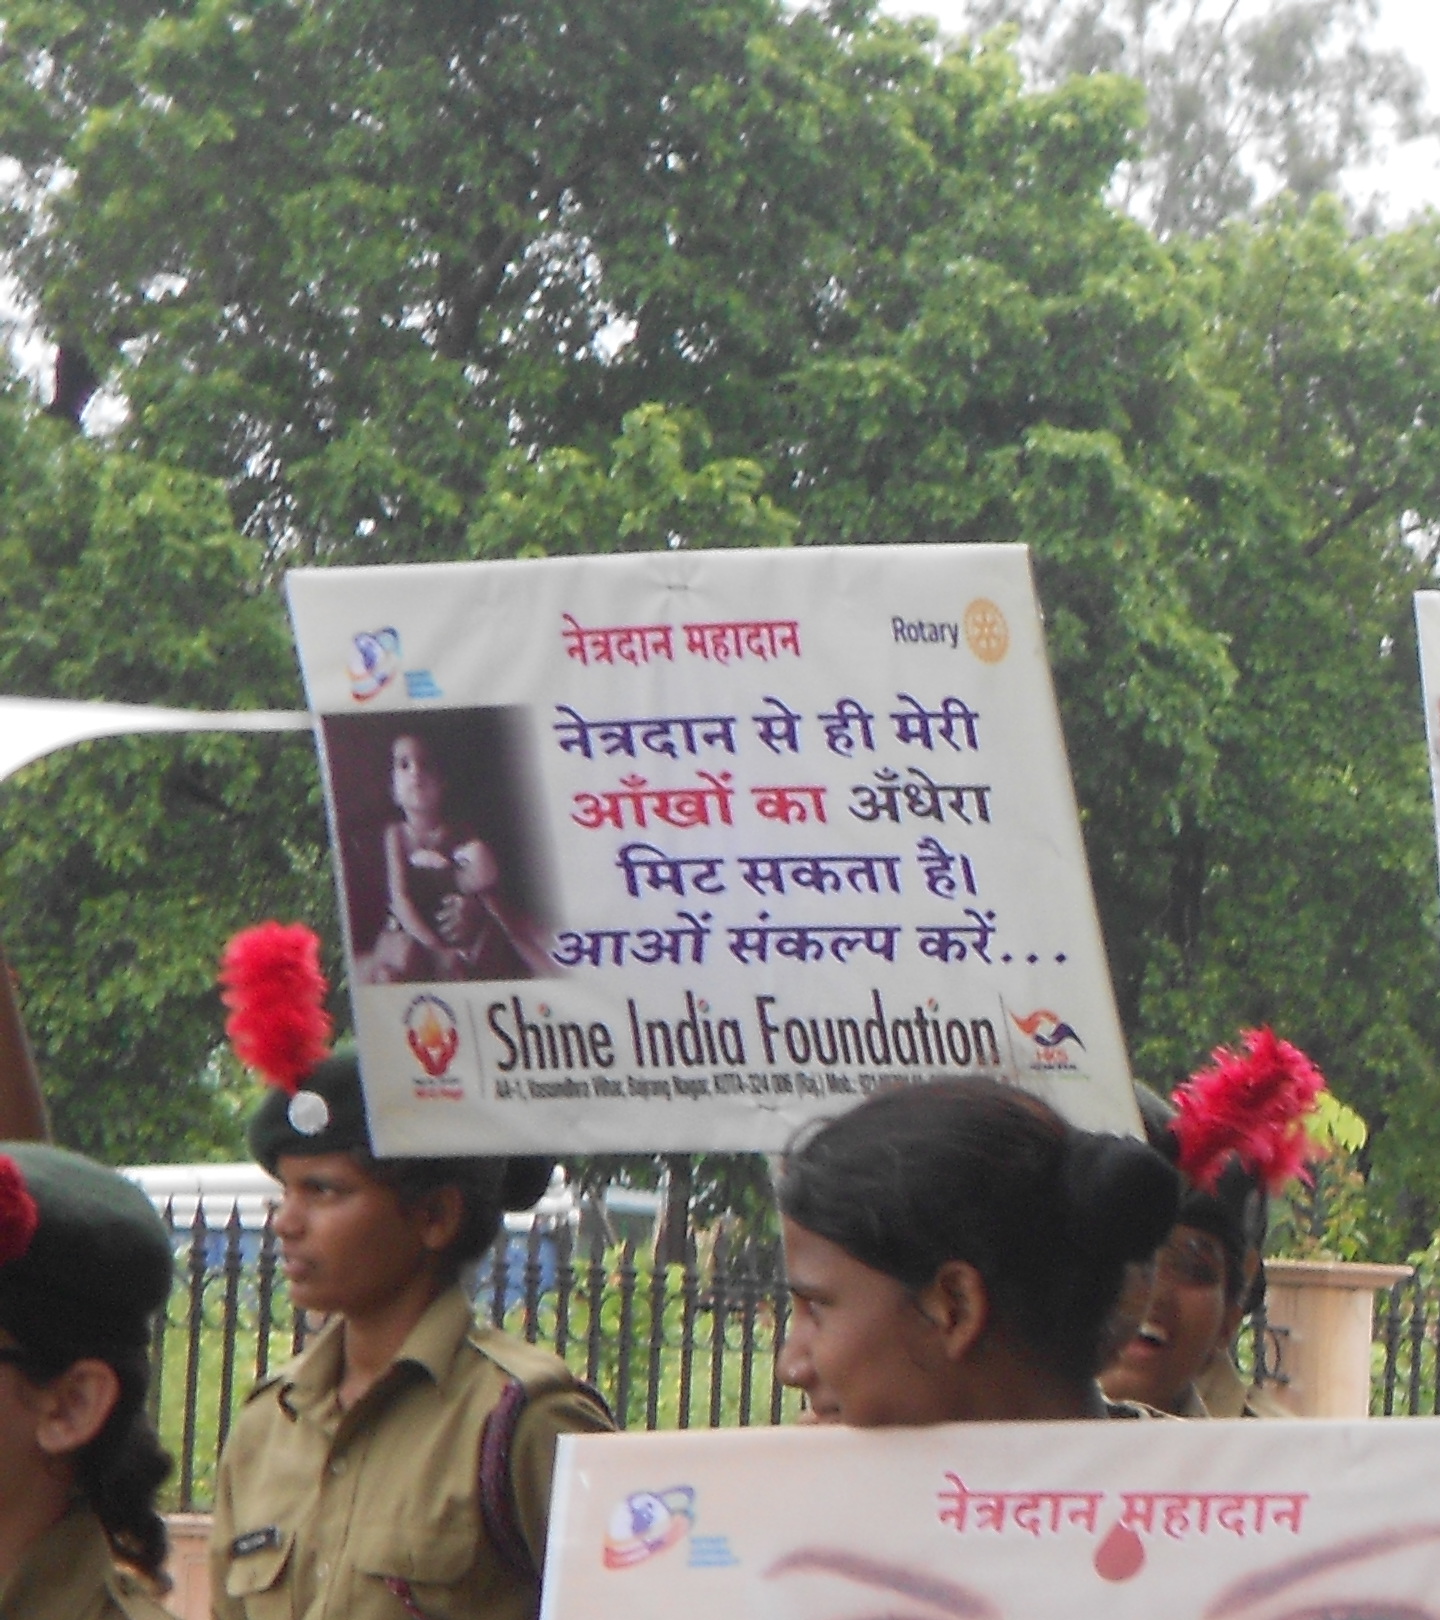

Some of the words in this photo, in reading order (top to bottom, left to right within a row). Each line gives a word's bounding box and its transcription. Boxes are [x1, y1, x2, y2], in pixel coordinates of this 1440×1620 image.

[561, 612, 674, 667] नेत्रदान
[682, 620, 802, 666] महादान
[892, 616, 960, 649] Rotary
[552, 704, 738, 760] नेत्रदान
[751, 695, 803, 755] से
[816, 696, 876, 758] ही
[889, 691, 980, 752] मेरी
[571, 770, 735, 830] आँखों
[750, 785, 829, 824] का
[848, 766, 992, 825] अँधेरा
[615, 843, 727, 898] मिट
[736, 855, 902, 896] सकता
[552, 909, 712, 968] आओं
[726, 909, 902, 965] संकल्प
[486, 995, 616, 1073] Shine
[626, 989, 747, 1068] India
[754, 988, 1001, 1067] Foundation
[936, 1470, 1104, 1537] नेत्रदान
[1120, 1491, 1310, 1538] महादान
